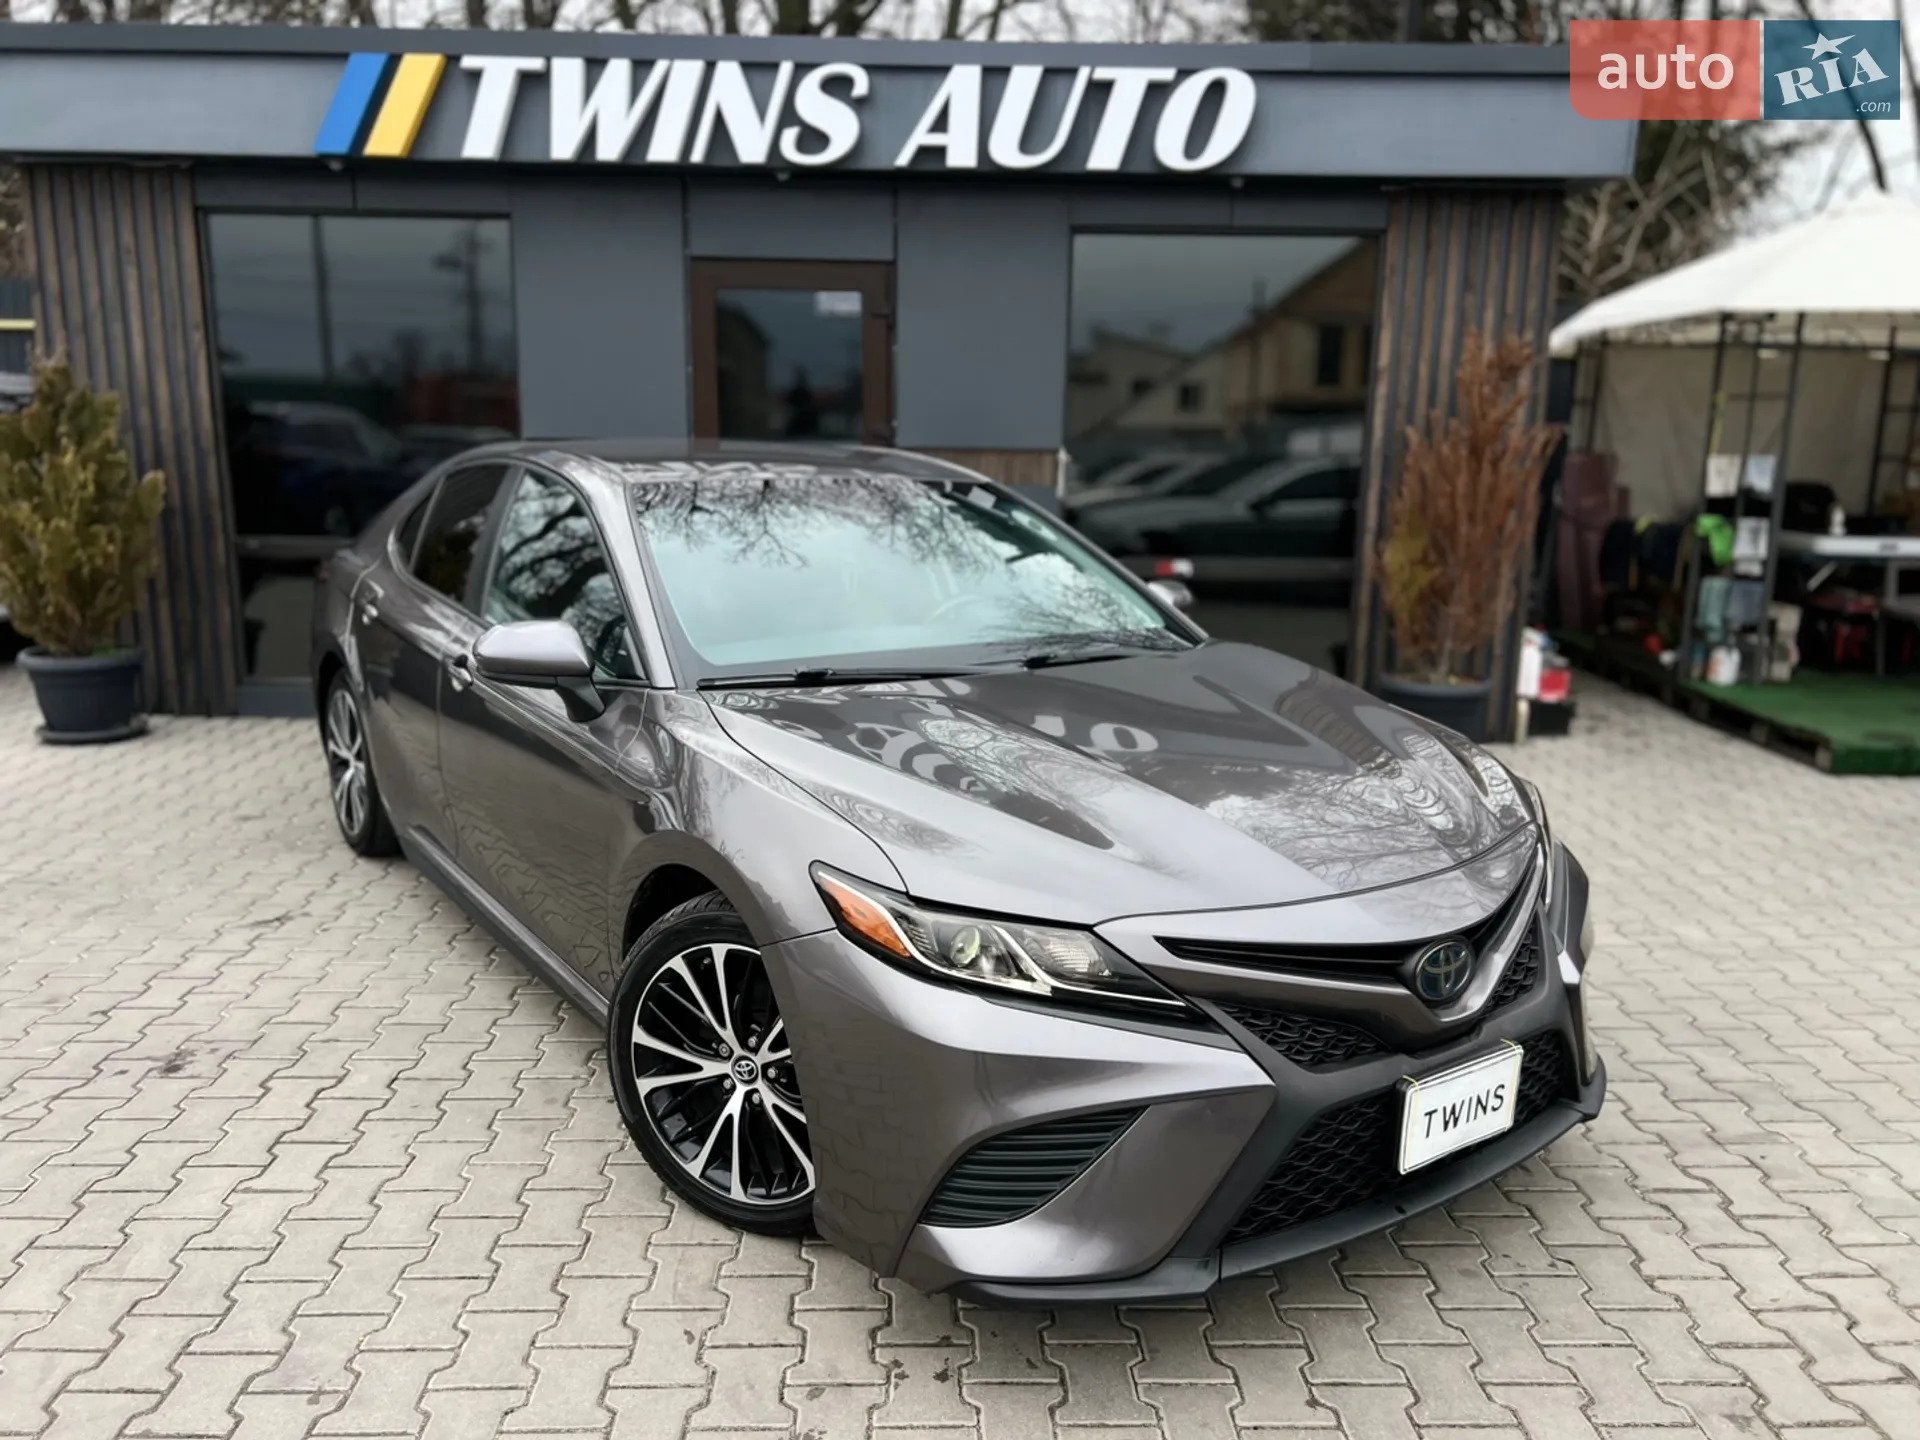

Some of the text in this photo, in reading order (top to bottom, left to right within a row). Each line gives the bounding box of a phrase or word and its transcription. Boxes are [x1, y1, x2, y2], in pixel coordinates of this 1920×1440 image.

[459, 54, 1258, 172] TWINS AUTO
[1424, 1083, 1505, 1139] TWINS
